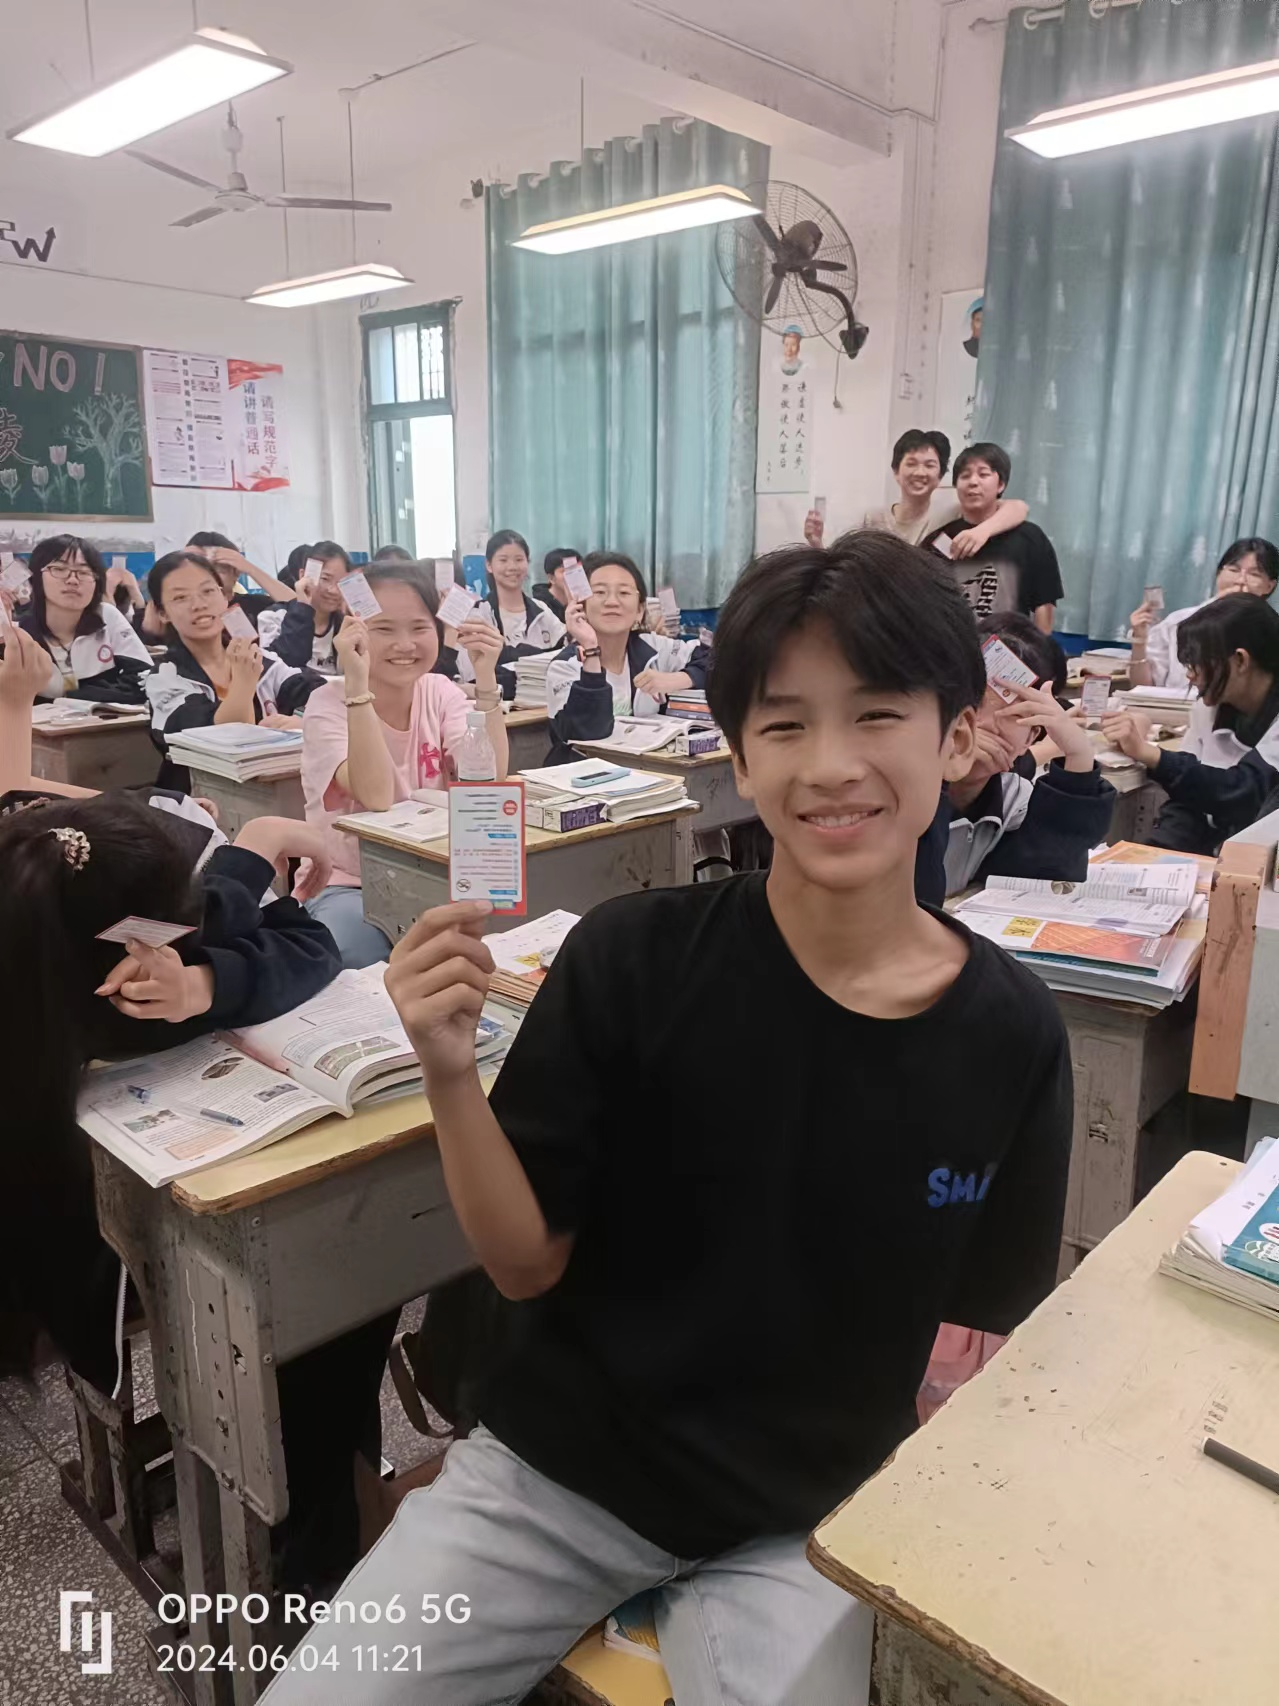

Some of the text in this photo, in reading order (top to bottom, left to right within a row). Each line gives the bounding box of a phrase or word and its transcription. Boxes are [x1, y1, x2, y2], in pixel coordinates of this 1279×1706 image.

[243, 381, 260, 455] 请讲普通话
[261, 395, 278, 469] 请写规范字
